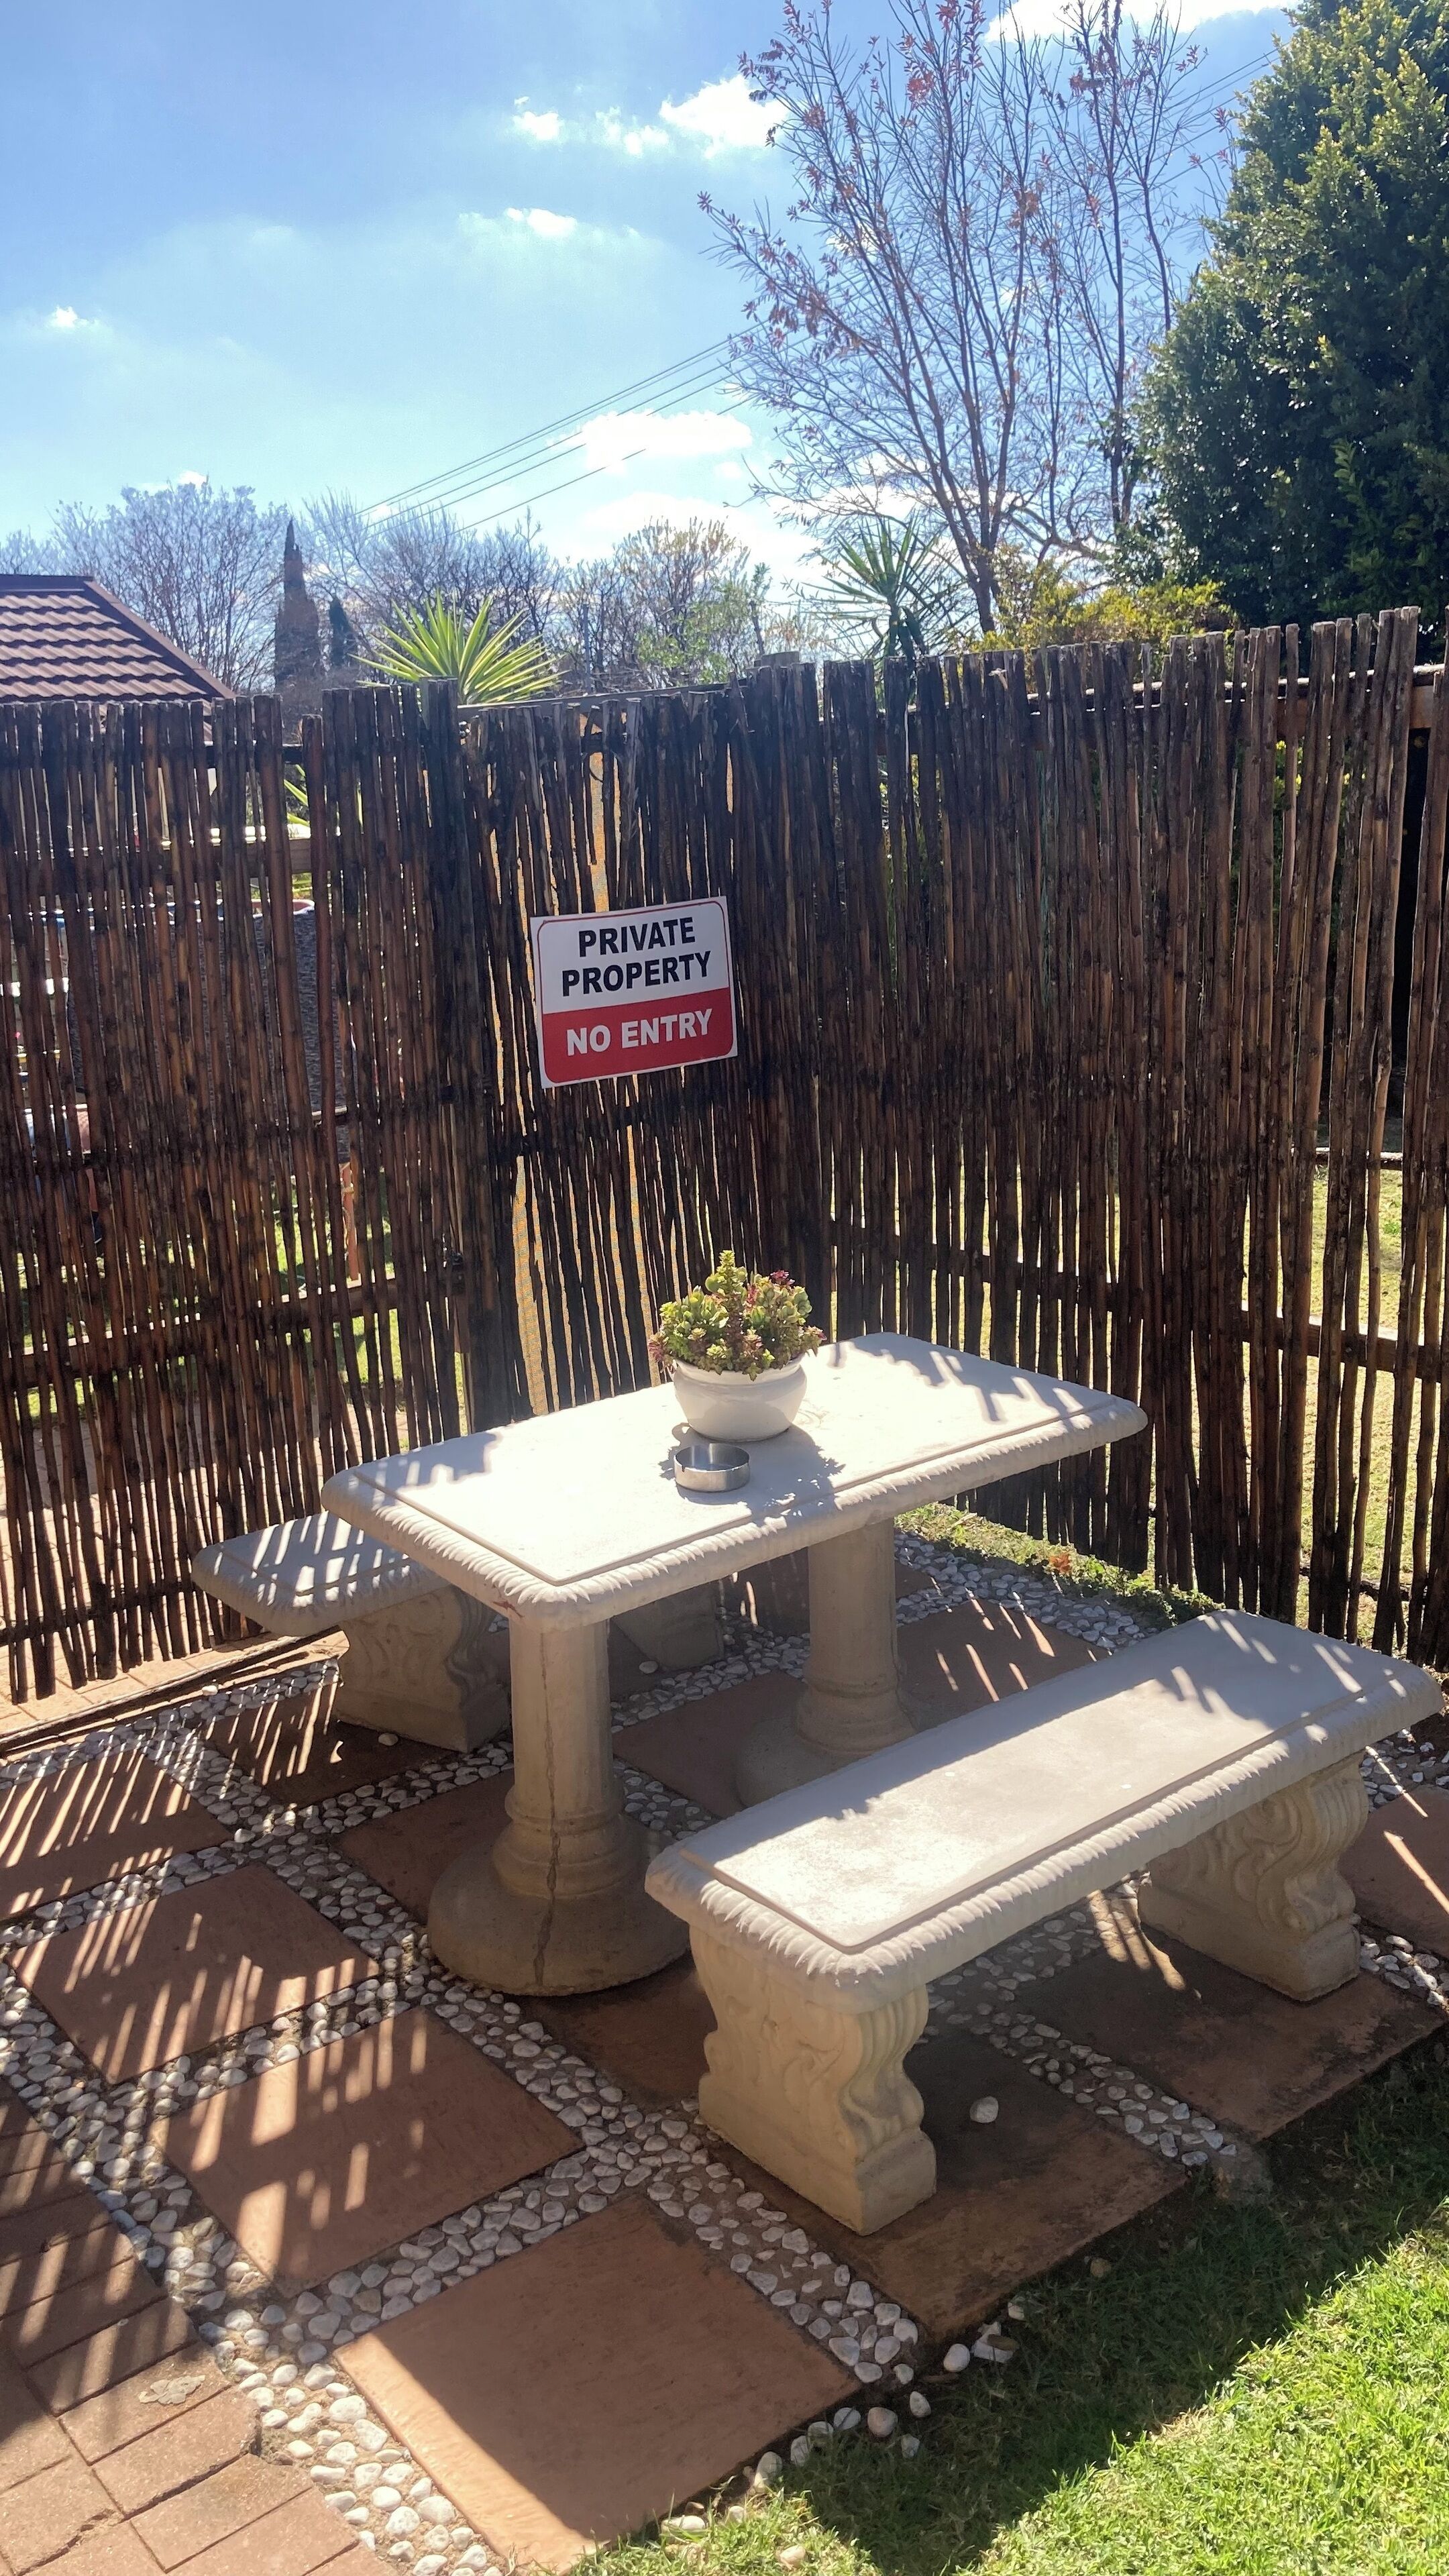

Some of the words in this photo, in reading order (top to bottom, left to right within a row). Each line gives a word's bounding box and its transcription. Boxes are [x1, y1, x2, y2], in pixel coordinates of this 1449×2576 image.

[579, 917, 696, 957] PRIVATE
[562, 951, 711, 997] PROPERTY
[566, 1025, 611, 1057] NO
[621, 1008, 712, 1049] ENTRY
